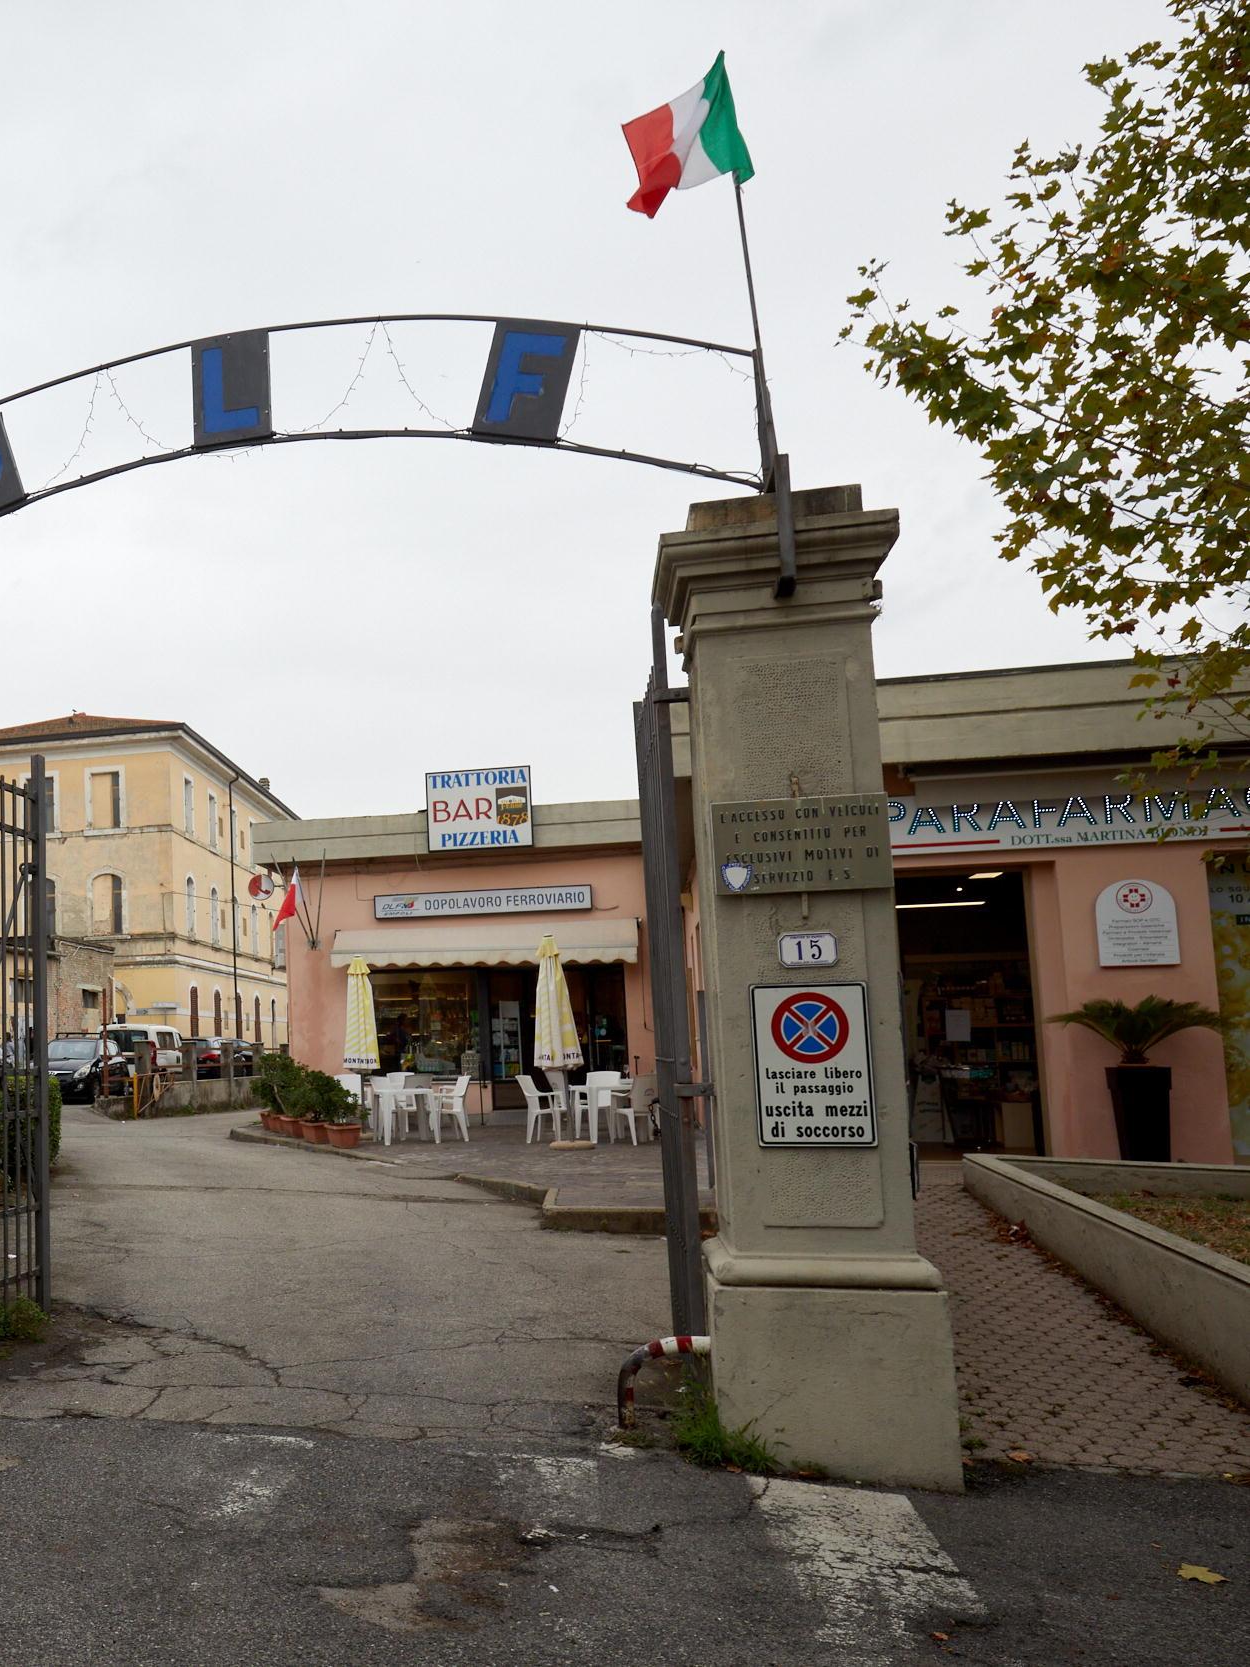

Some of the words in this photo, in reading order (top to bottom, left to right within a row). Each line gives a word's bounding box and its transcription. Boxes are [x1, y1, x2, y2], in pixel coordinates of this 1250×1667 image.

[202, 347, 260, 433] L
[484, 331, 566, 423] F
[429, 769, 527, 789] TRATTORIA
[432, 797, 493, 823] BAR
[796, 806, 819, 819] CON
[888, 786, 1250, 835] PARAFARMA
[441, 829, 519, 848] PIZZERIA
[844, 826, 866, 838] PER
[1077, 829, 1146, 842] MARTINA
[726, 850, 792, 864] ESCLUSIVI
[805, 847, 853, 861] MOTIVI
[867, 846, 879, 858] DI
[754, 869, 814, 884] SERVIZIO
[424, 896, 501, 911] DOPOLAVORO
[506, 891, 585, 907] FERROVIARIO
[796, 939, 822, 961] 15
[766, 1067, 817, 1079] lasciare
[824, 1067, 862, 1079] libero
[775, 1082, 786, 1094] il
[793, 1081, 854, 1096] passaggio
[765, 1100, 814, 1117] uscita
[825, 1100, 868, 1117] mezzi
[771, 1121, 786, 1138] di
[796, 1126, 865, 1138] soccorso
